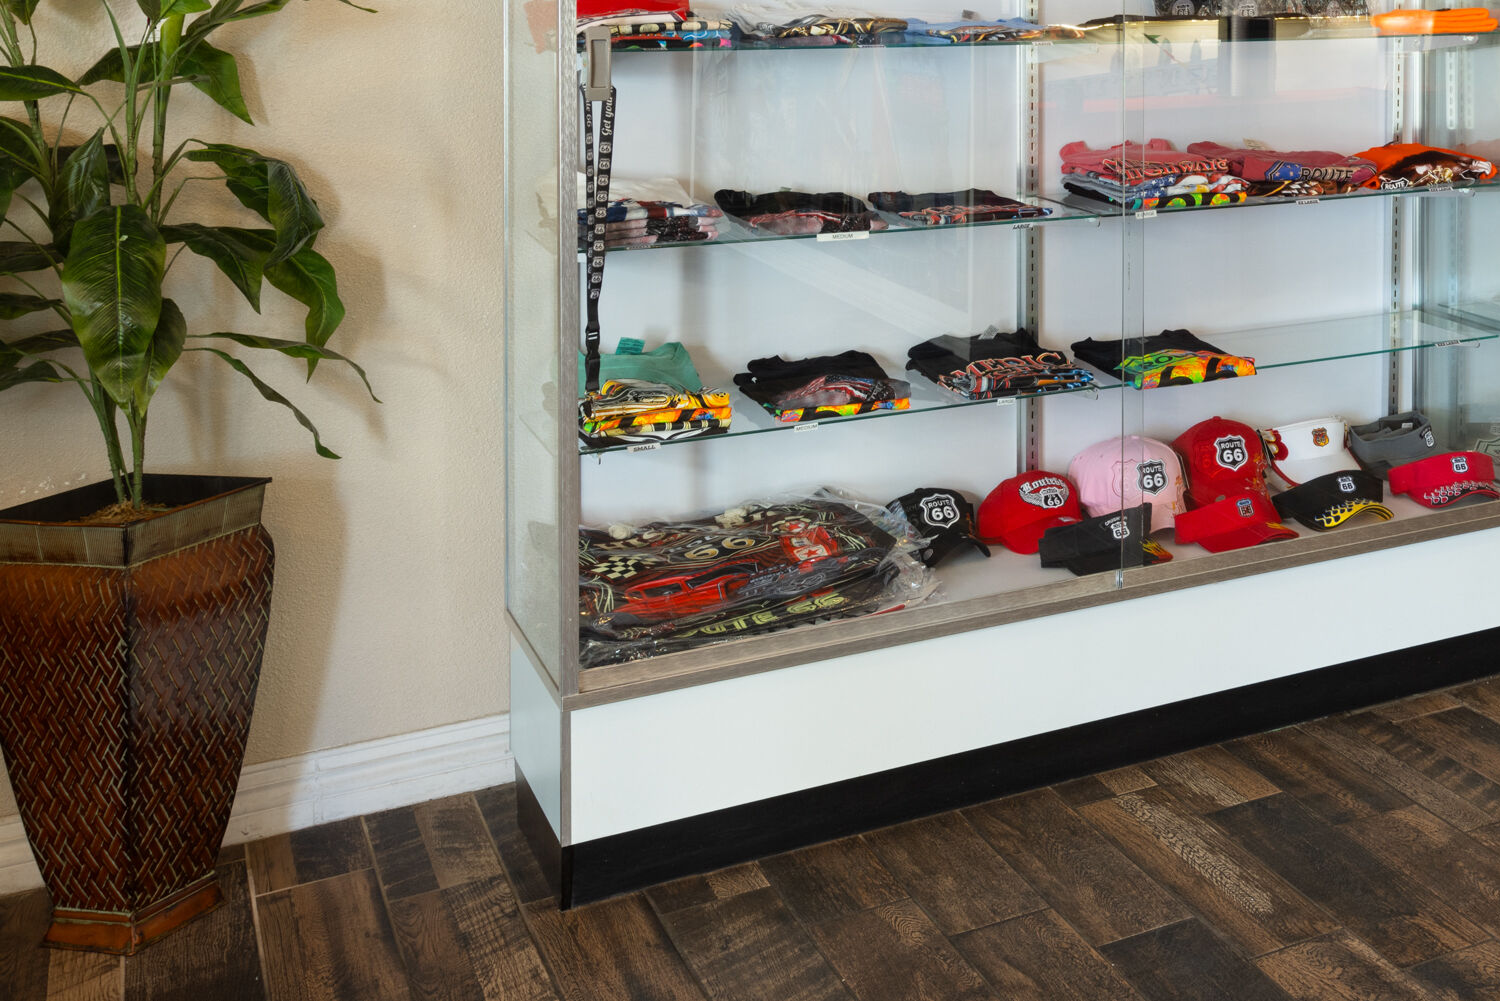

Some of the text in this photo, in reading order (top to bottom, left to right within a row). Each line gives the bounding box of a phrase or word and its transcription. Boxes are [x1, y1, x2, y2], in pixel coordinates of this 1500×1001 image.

[601, 120, 612, 136] Get
[1301, 166, 1354, 181] ROUTE
[1385, 181, 1406, 190] ROUTE
[796, 423, 818, 431] MEDIUM
[633, 444, 656, 452] SMALL
[1221, 441, 1241, 449] ROUTE
[1223, 448, 1243, 463] 66
[1143, 465, 1162, 473] ROUTE
[1455, 463, 1467, 471] 66
[1143, 473, 1164, 488] 66
[927, 499, 951, 509] ROUTE
[1047, 496, 1061, 505] 66
[931, 505, 955, 520] 66
[684, 535, 756, 560] 66
[787, 592, 845, 615] 66
